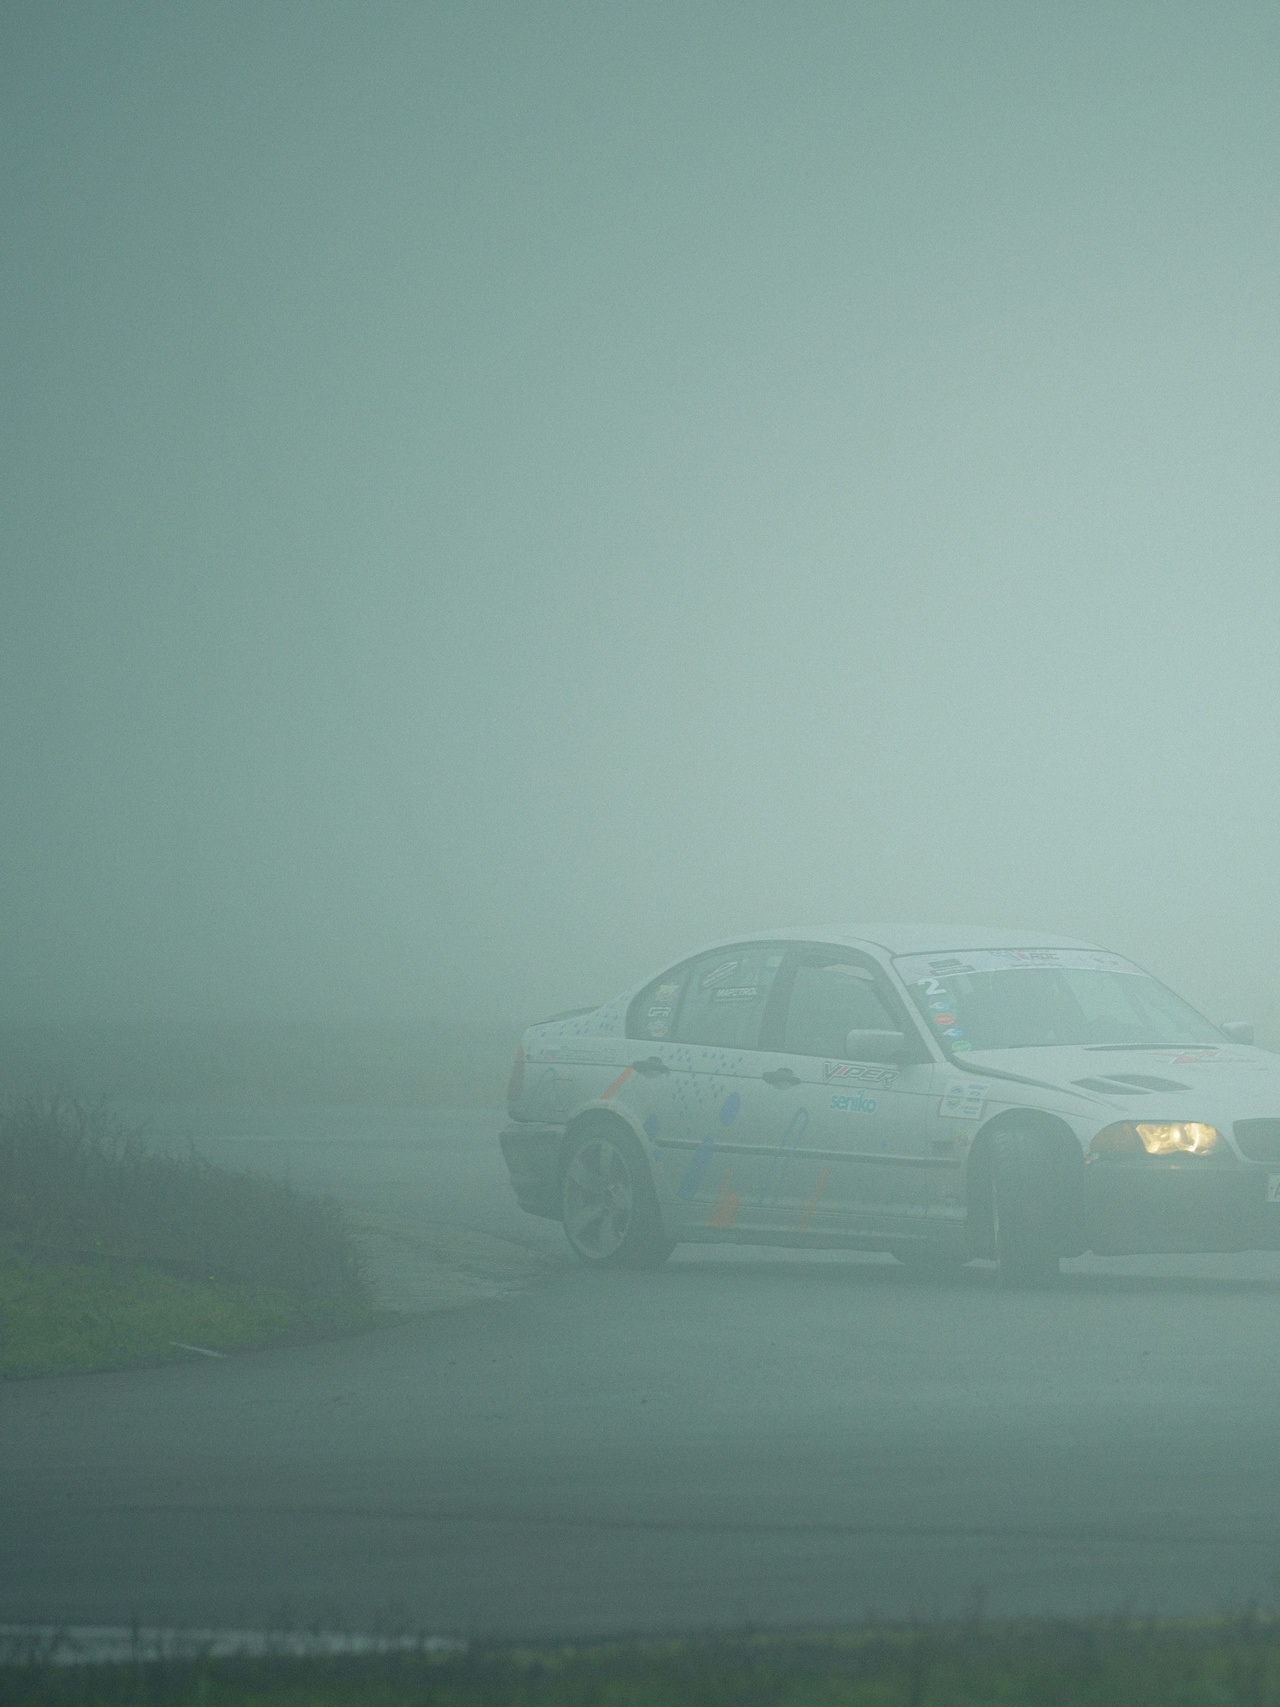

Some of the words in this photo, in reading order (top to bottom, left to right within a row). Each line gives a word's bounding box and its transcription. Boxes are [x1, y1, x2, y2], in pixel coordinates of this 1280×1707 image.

[917, 978, 947, 996] 2
[822, 1061, 901, 1090] VIPER
[829, 1089, 877, 1115] seniko
